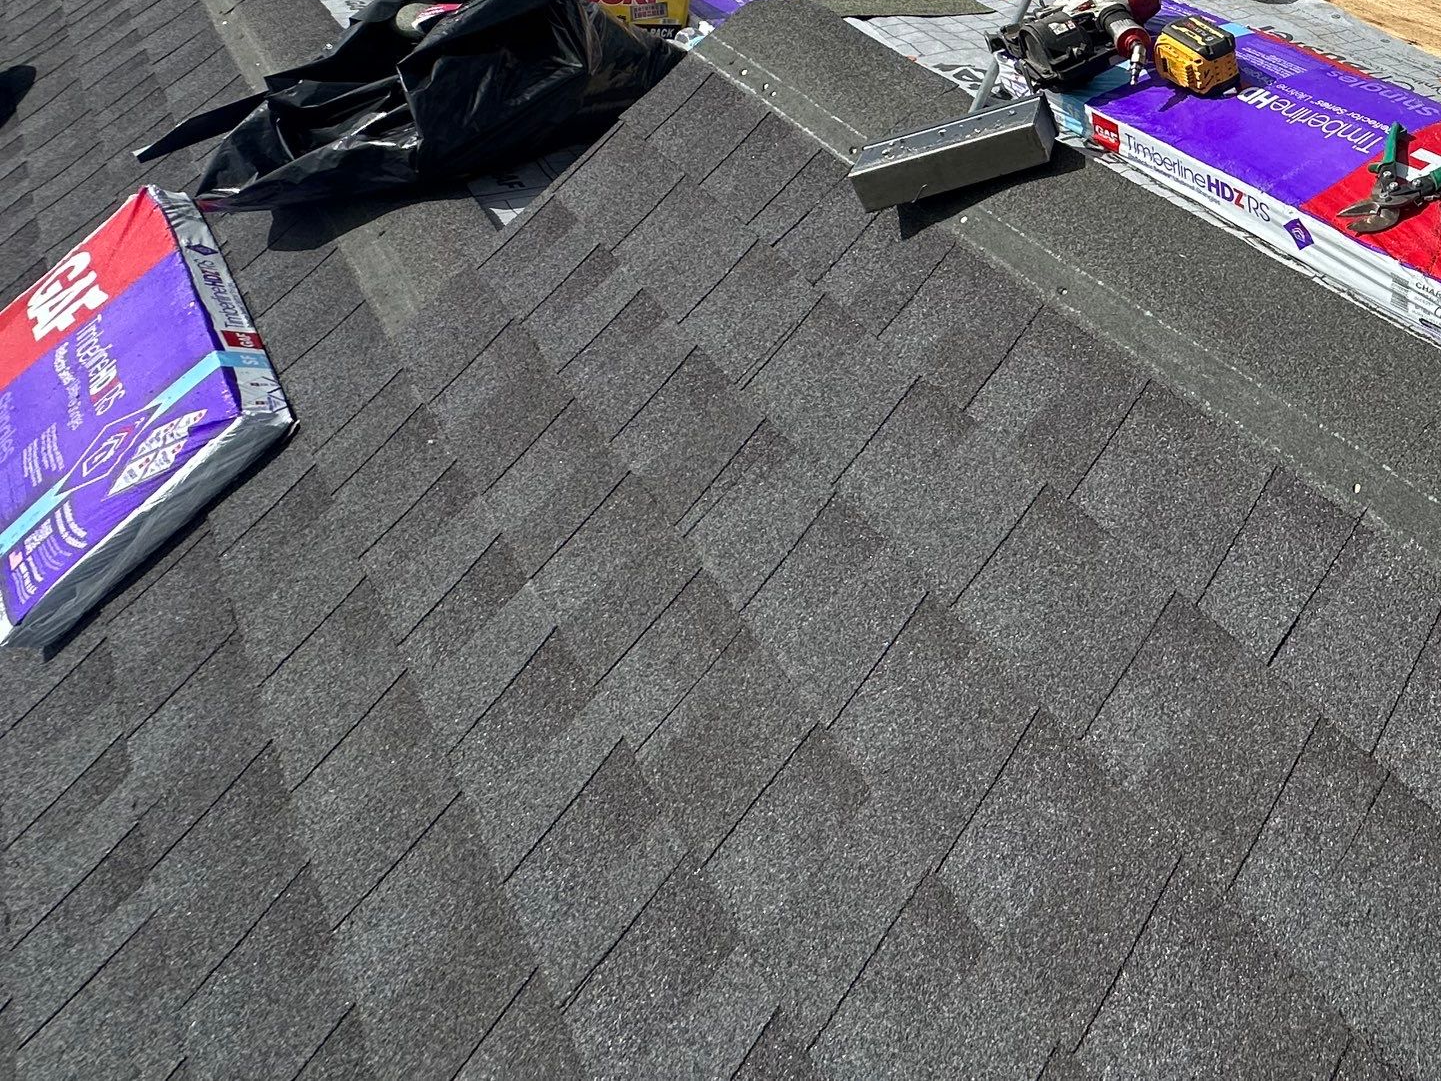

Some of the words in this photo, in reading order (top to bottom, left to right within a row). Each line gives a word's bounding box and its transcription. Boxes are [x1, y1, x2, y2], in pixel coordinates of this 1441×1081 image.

[1094, 123, 1119, 143] GAF
[1125, 132, 1246, 210] TimberlineHDZ
[1247, 195, 1271, 222] RS
[27, 251, 109, 342] GAF
